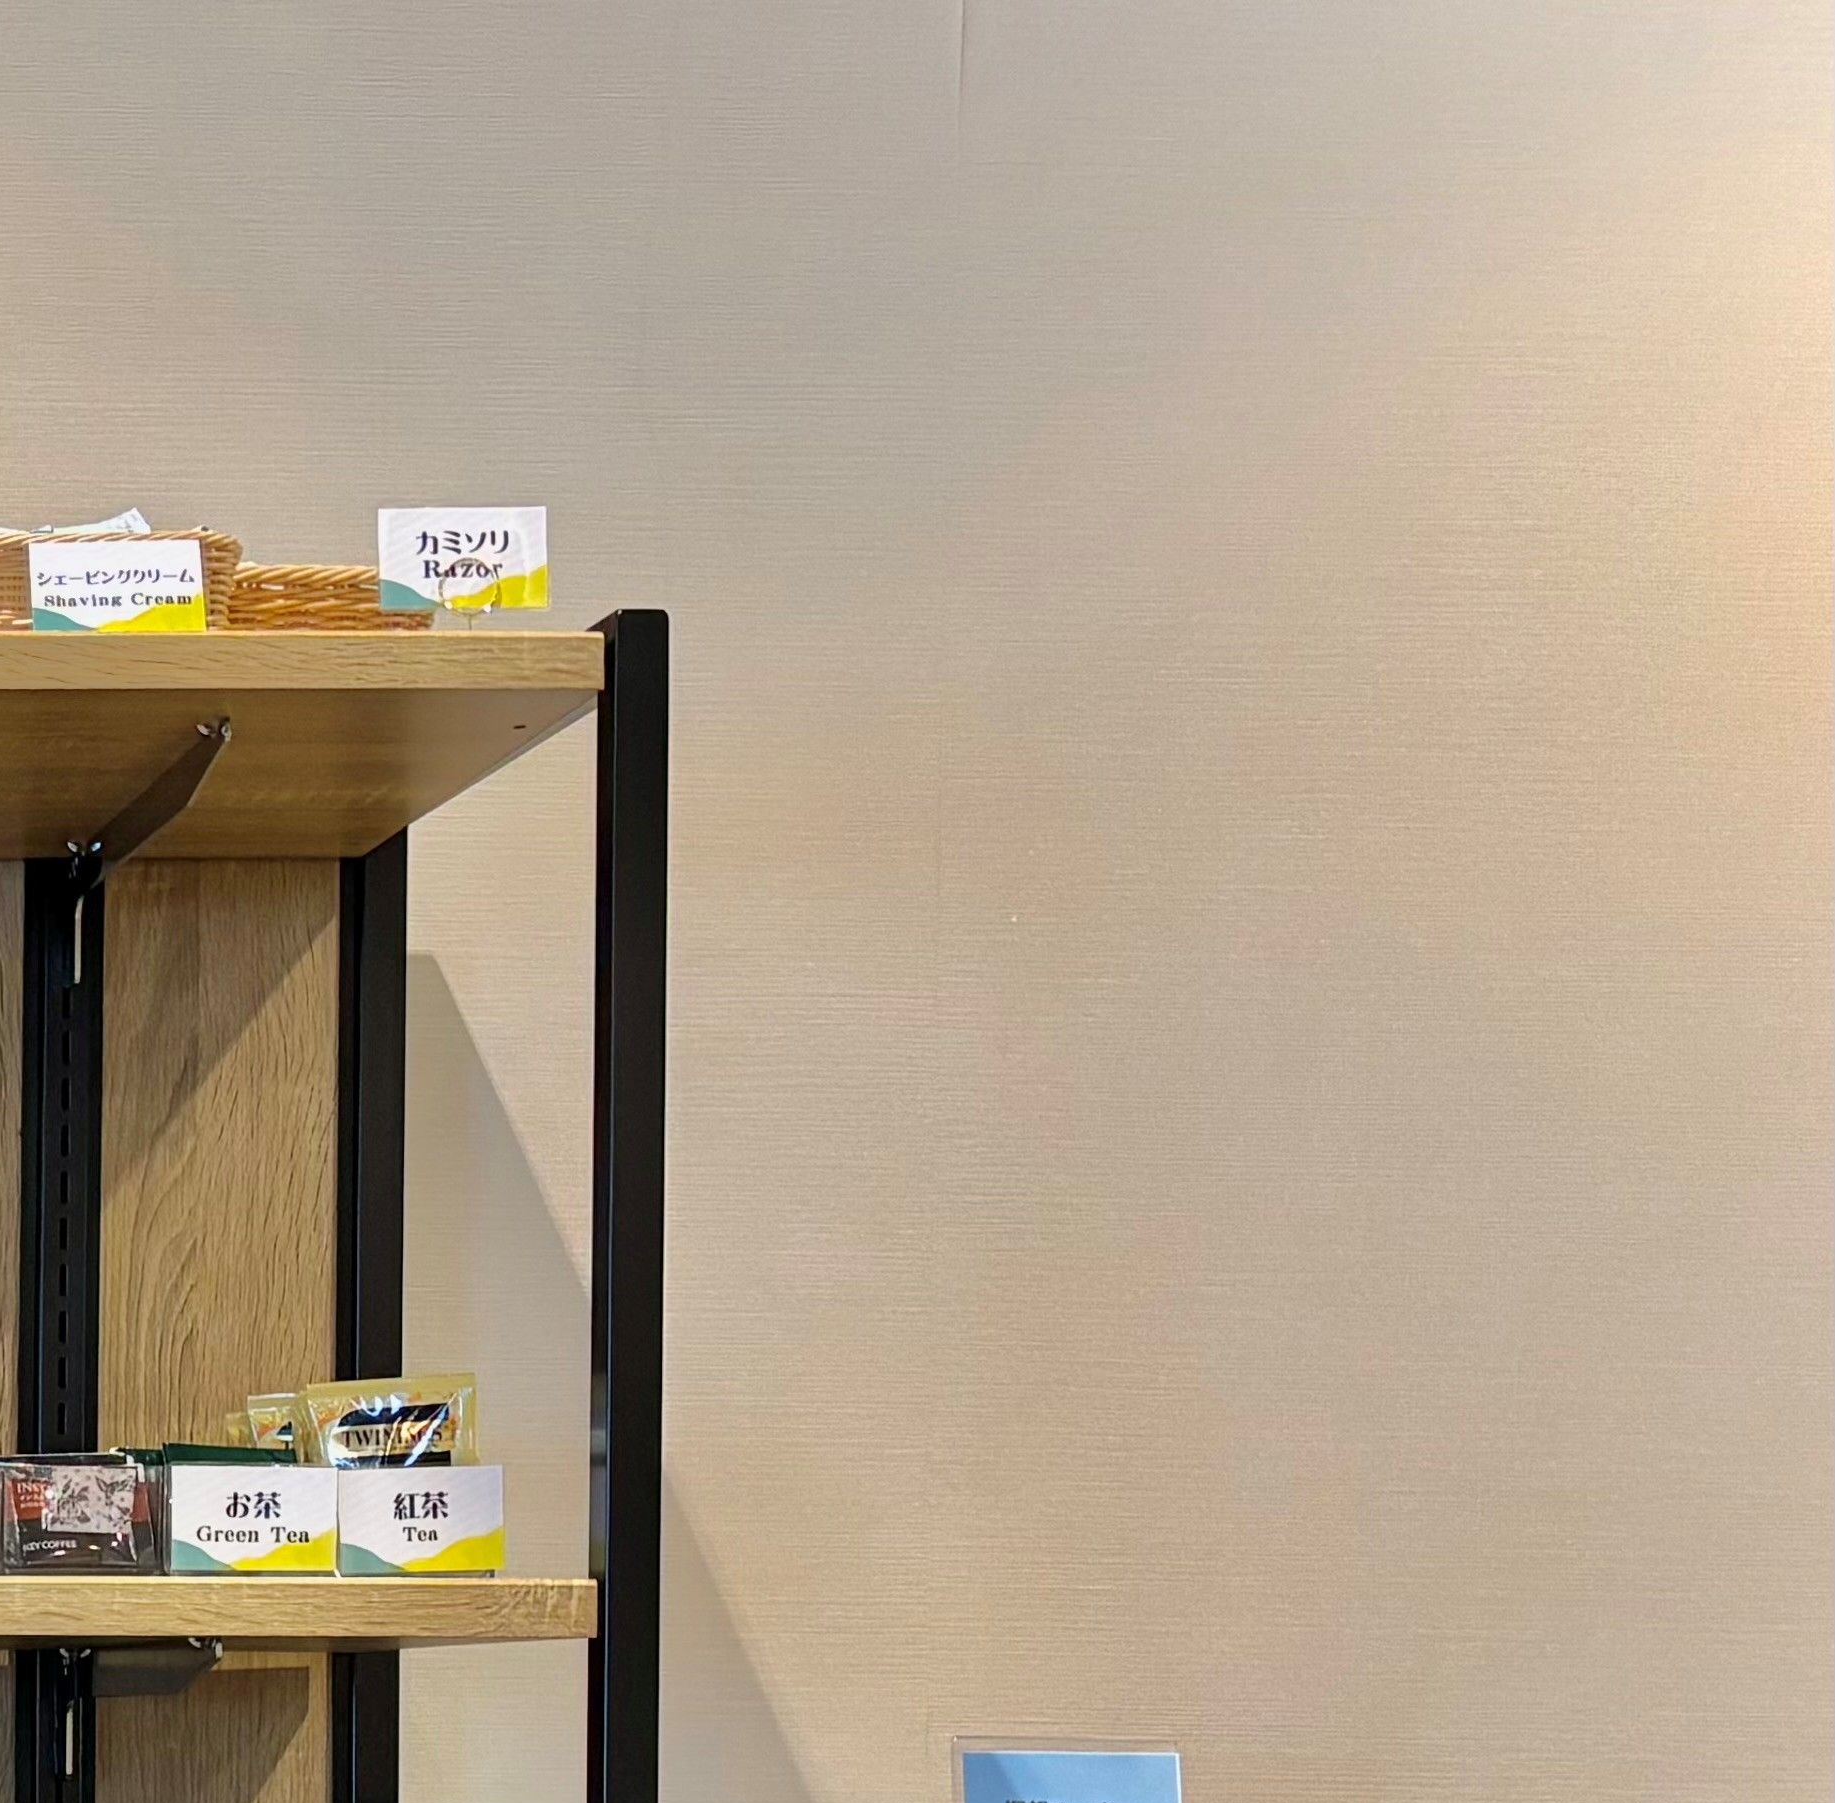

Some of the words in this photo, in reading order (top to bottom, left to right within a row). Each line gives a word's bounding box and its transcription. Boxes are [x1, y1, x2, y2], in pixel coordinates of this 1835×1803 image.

[415, 530, 509, 555] カミソリ
[36, 568, 195, 587] シェービングクリーム
[423, 559, 503, 579] Razor
[44, 594, 122, 607] Shaving
[131, 592, 192, 606] Cream
[225, 1491, 282, 1520] お茶
[392, 1490, 449, 1520] 紅茶
[196, 1525, 259, 1544] Green
[270, 1525, 310, 1544] Tea
[403, 1526, 438, 1544] Tea
